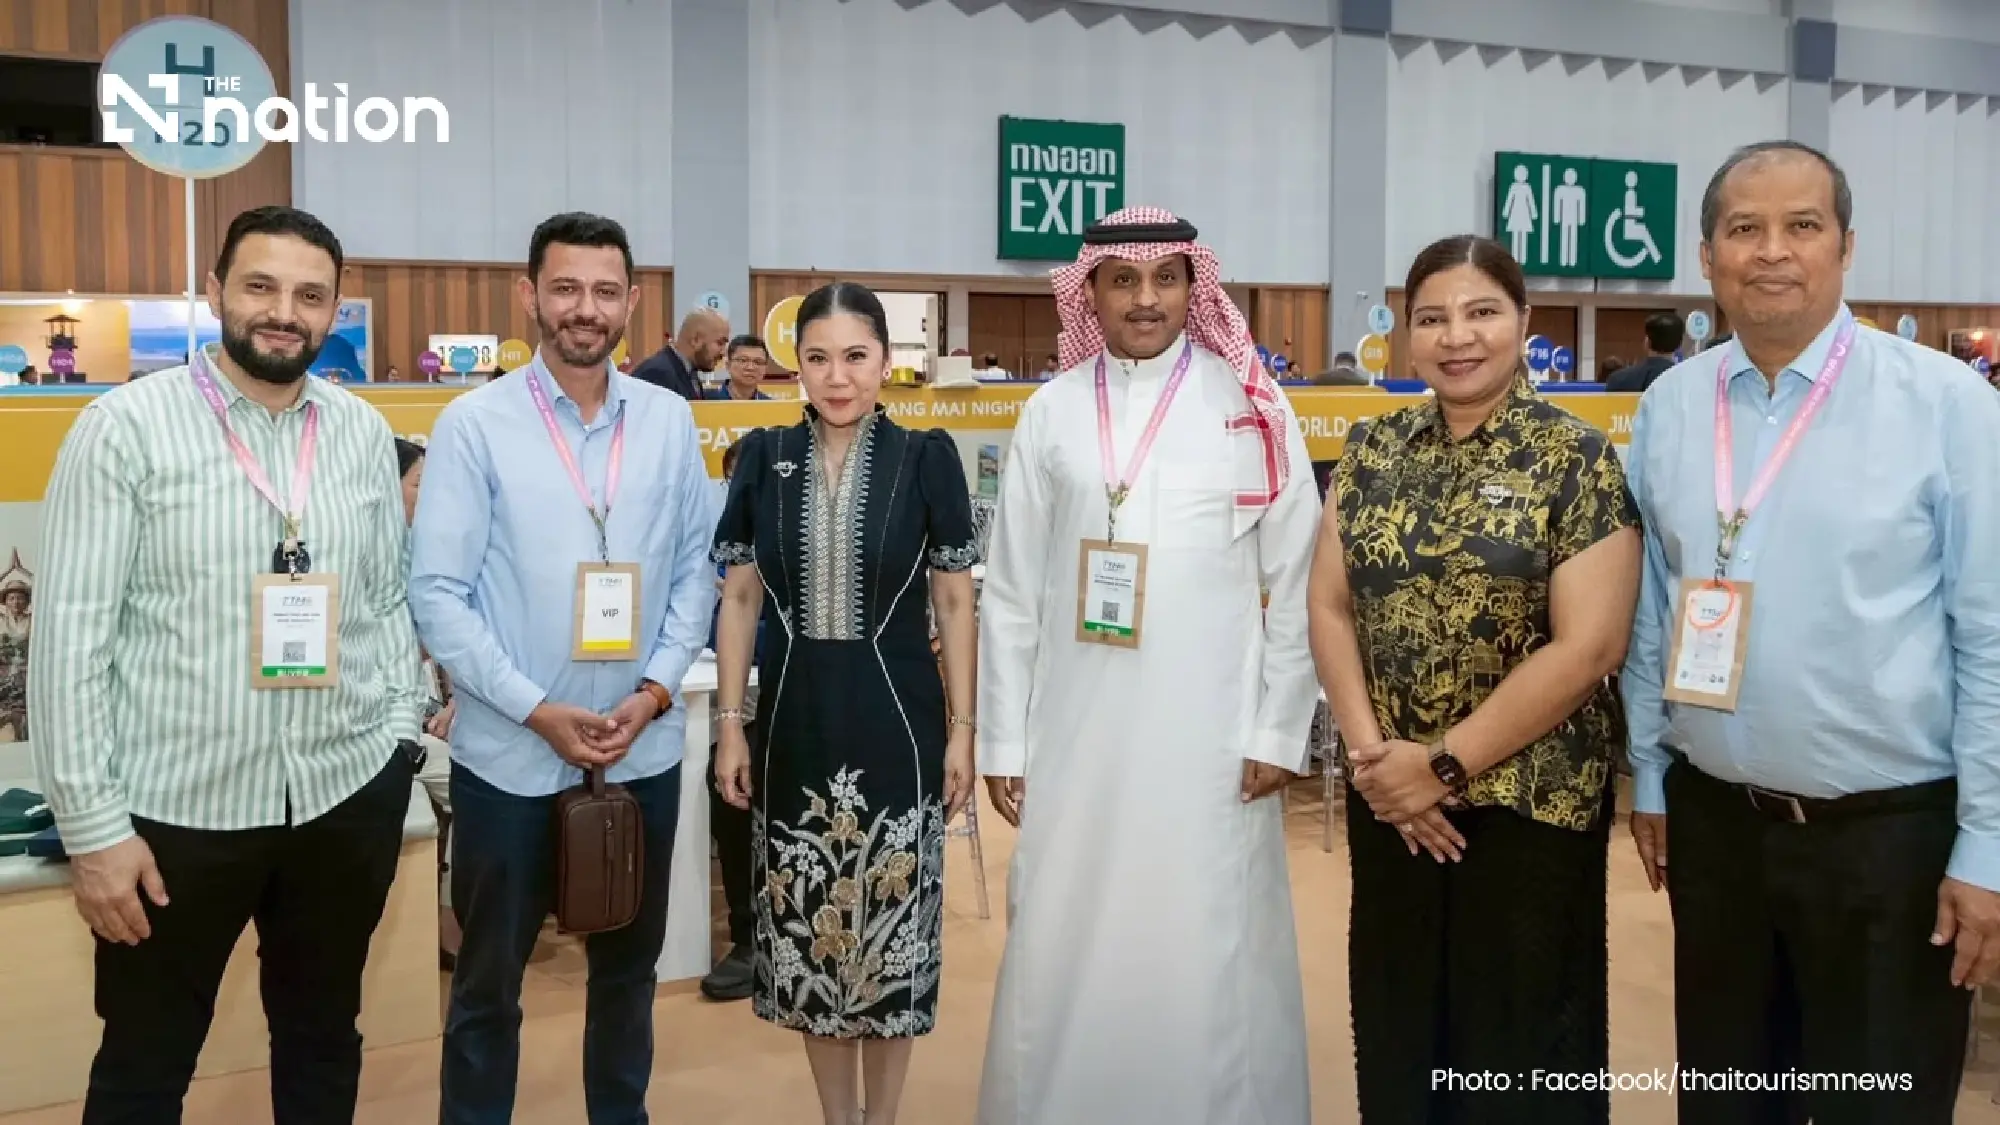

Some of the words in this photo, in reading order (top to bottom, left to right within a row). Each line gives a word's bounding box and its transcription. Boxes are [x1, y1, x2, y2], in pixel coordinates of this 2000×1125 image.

[1010, 142, 1117, 176] ทางออก
[1010, 176, 1117, 236] EXIT
[932, 402, 967, 417] MAI
[601, 608, 620, 618] VIP
